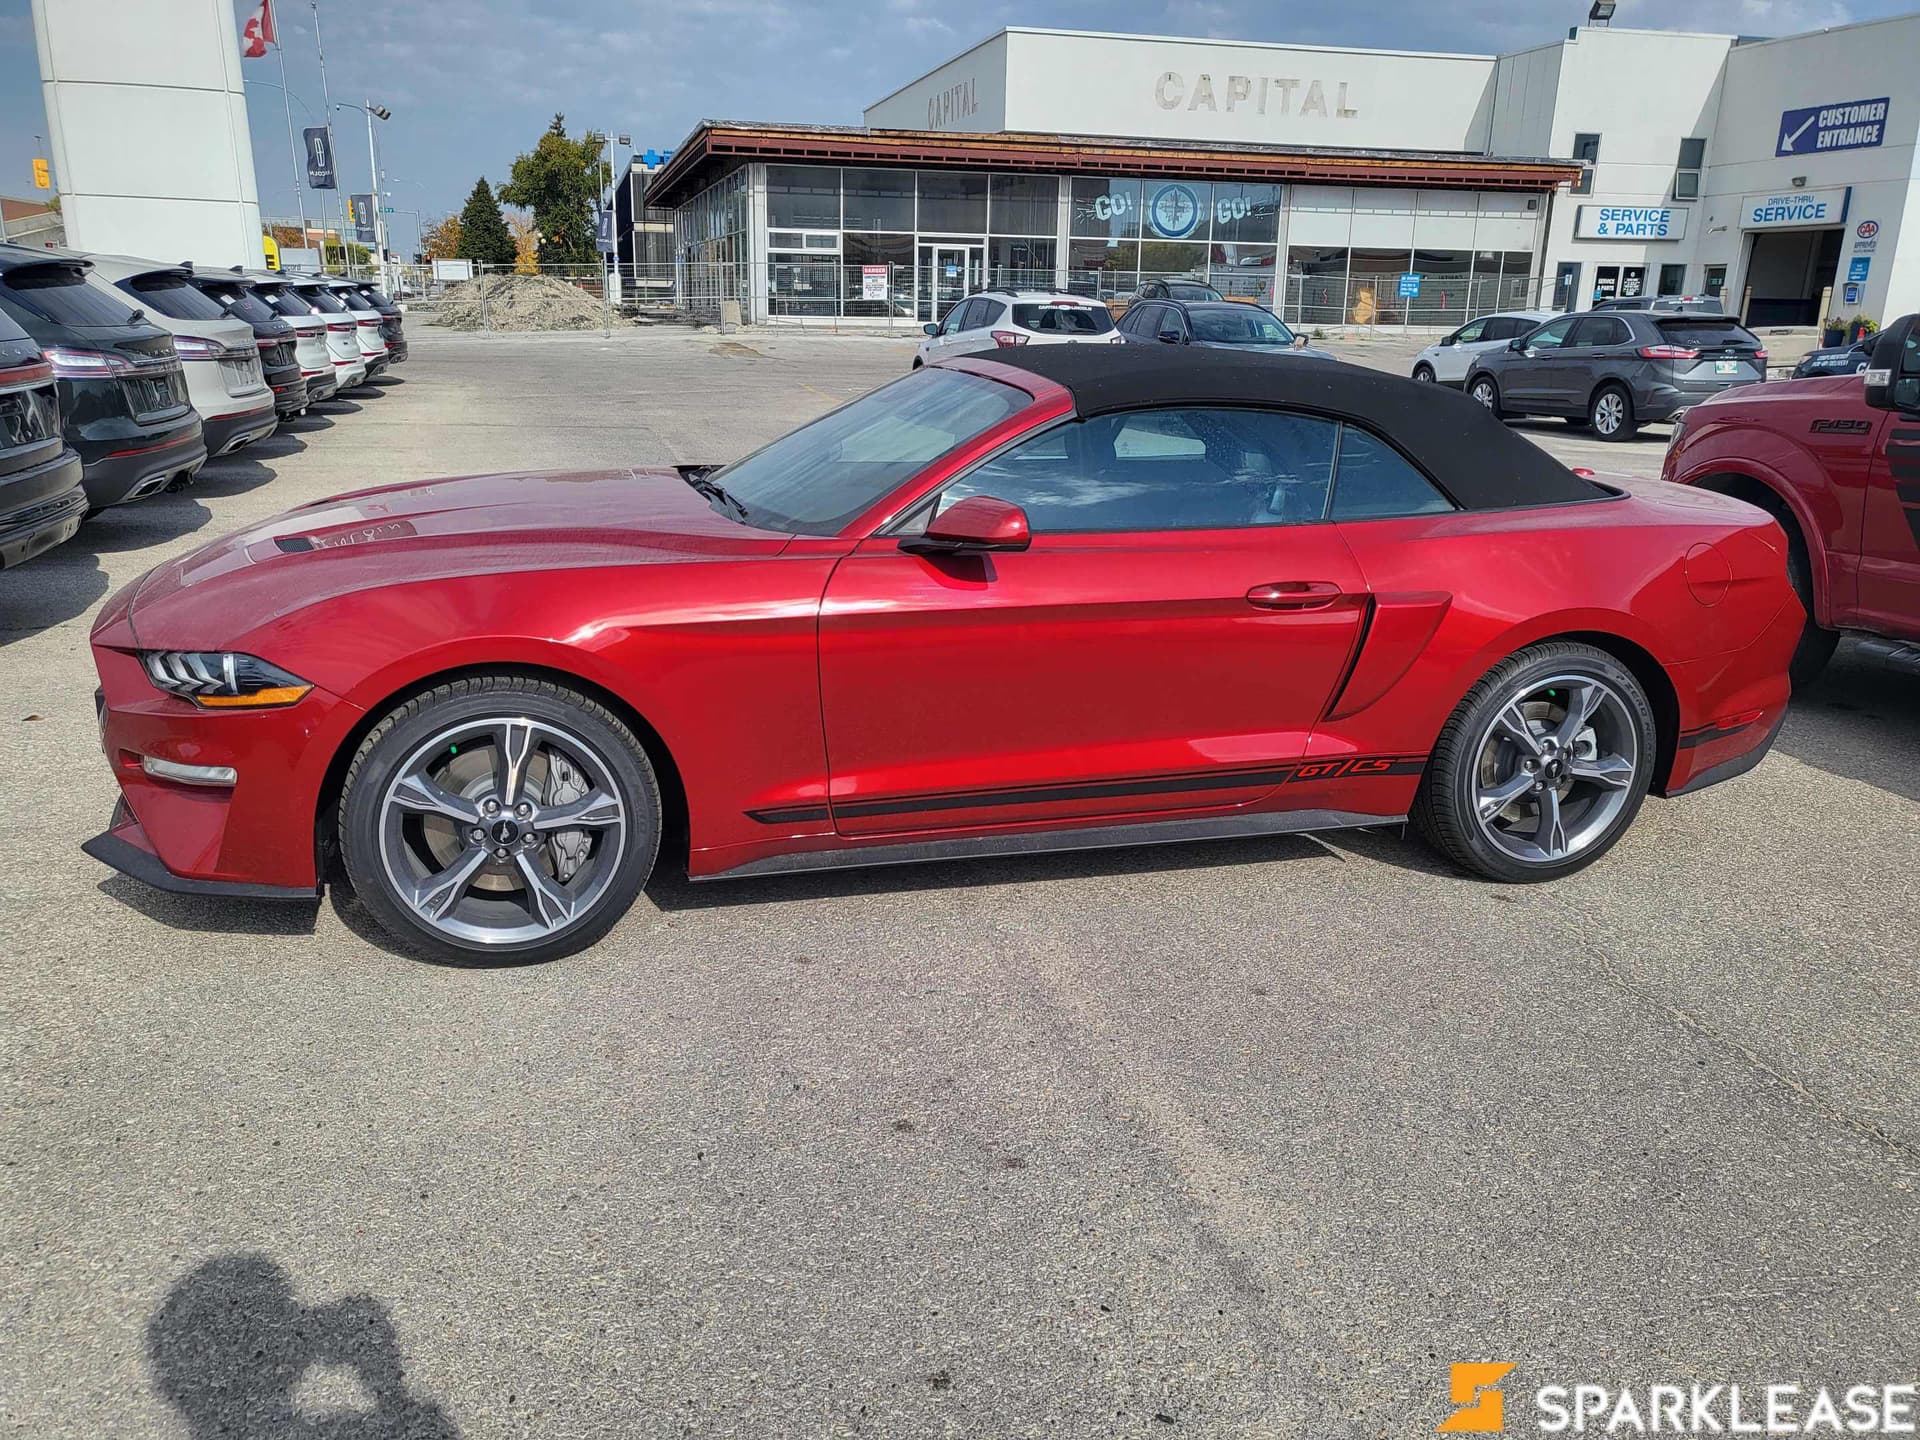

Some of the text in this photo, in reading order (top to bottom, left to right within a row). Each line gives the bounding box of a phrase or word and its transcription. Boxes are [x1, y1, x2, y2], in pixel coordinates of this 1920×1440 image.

[928, 78, 979, 129] CAPITAL
[1154, 71, 1359, 118] CAPITAL
[1818, 102, 1886, 128] CUSTOMER
[1816, 124, 1881, 149] ENTRANCE
[1095, 191, 1252, 224] GO! GO!
[1767, 195, 1815, 206] DRIVE-THRU
[1599, 208, 1671, 223] SERVICE
[1752, 203, 1827, 223] SERVICE
[1597, 222, 1668, 237] & PARTS
[1298, 758, 1396, 777] GT/CS
